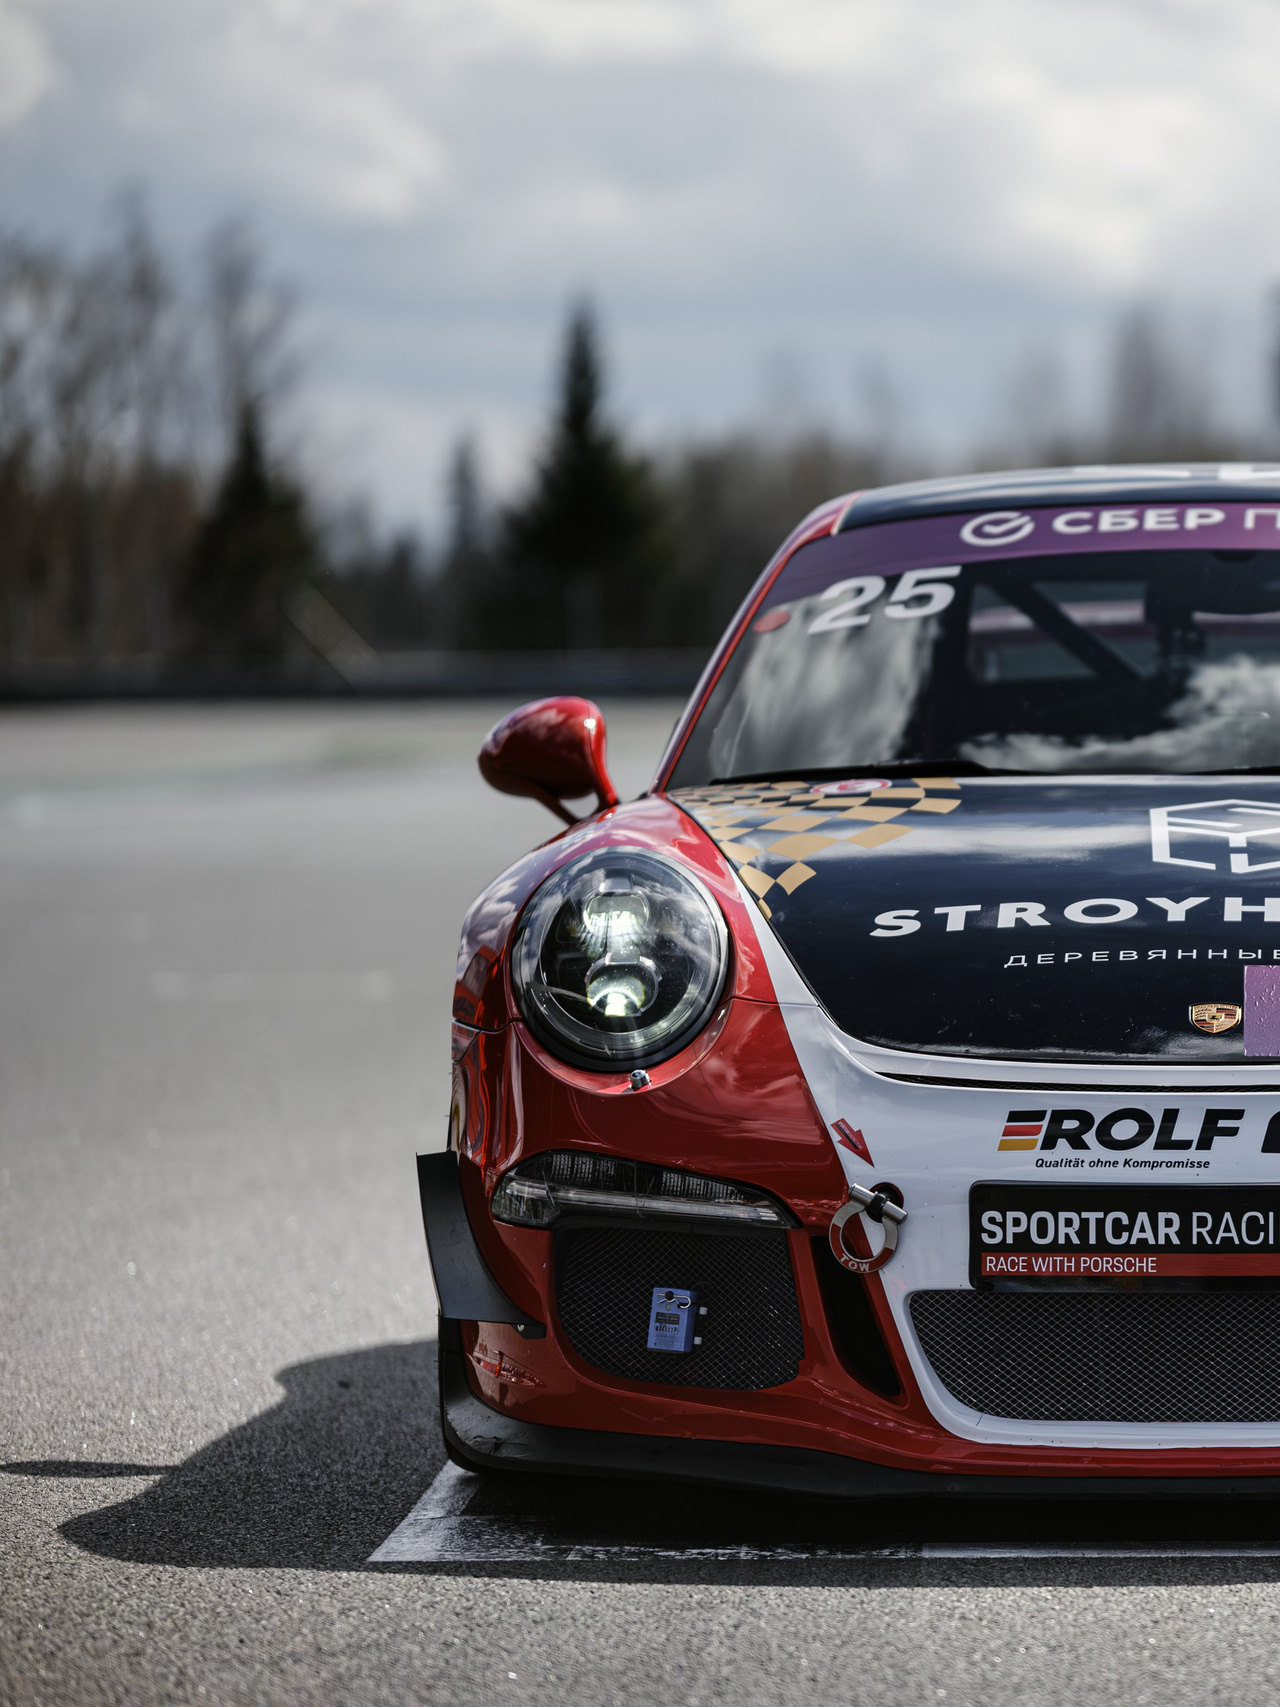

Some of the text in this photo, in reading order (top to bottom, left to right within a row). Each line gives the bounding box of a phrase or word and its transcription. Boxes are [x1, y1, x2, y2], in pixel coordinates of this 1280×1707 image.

[1051, 507, 1225, 535] СБЕР
[807, 566, 962, 635] 25
[1040, 1107, 1246, 1151] ROLF
[1035, 1158, 1211, 1170] Qualität ohne Kompromisse
[981, 1210, 1181, 1245] SPORTCAR
[840, 1253, 870, 1273] TOW
[986, 1256, 1157, 1273] RACE WITH PORSCHE
